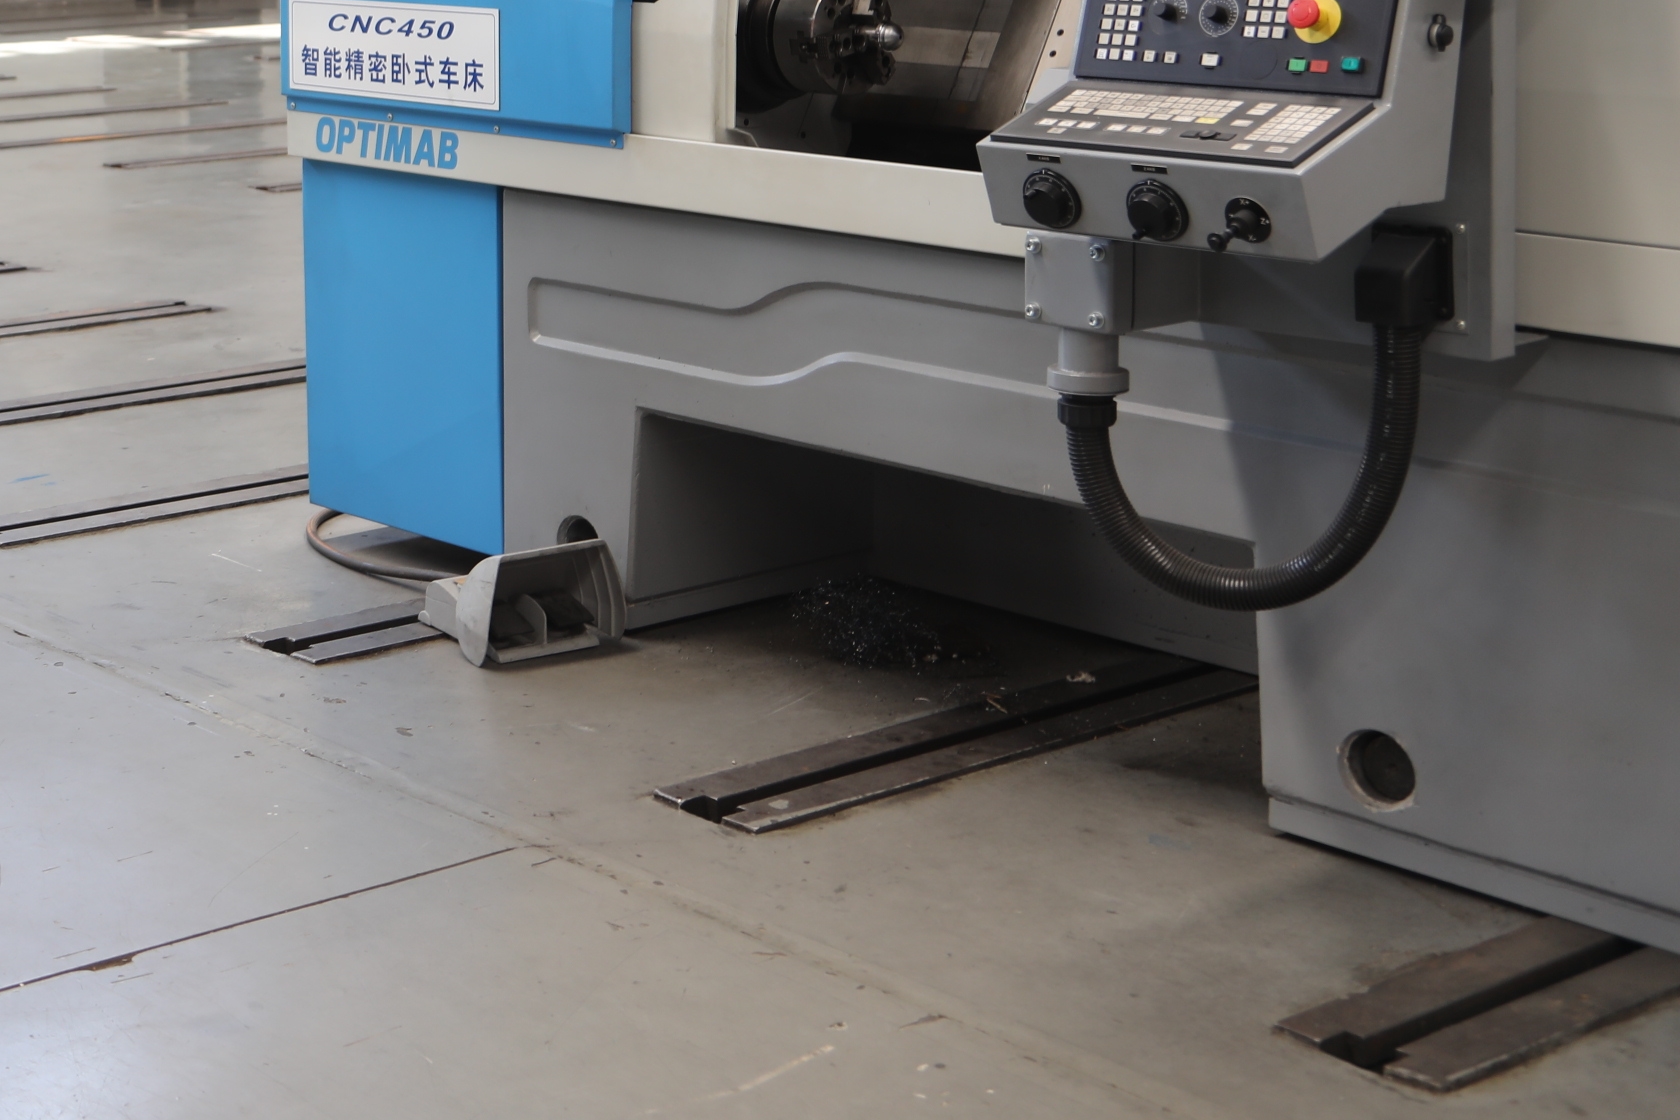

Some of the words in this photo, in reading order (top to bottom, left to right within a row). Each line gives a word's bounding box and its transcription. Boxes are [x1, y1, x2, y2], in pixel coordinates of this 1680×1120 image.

[328, 13, 455, 40] CNC450
[301, 44, 485, 93] 智能精密卧式车床
[315, 116, 460, 171] OPTIMAB
